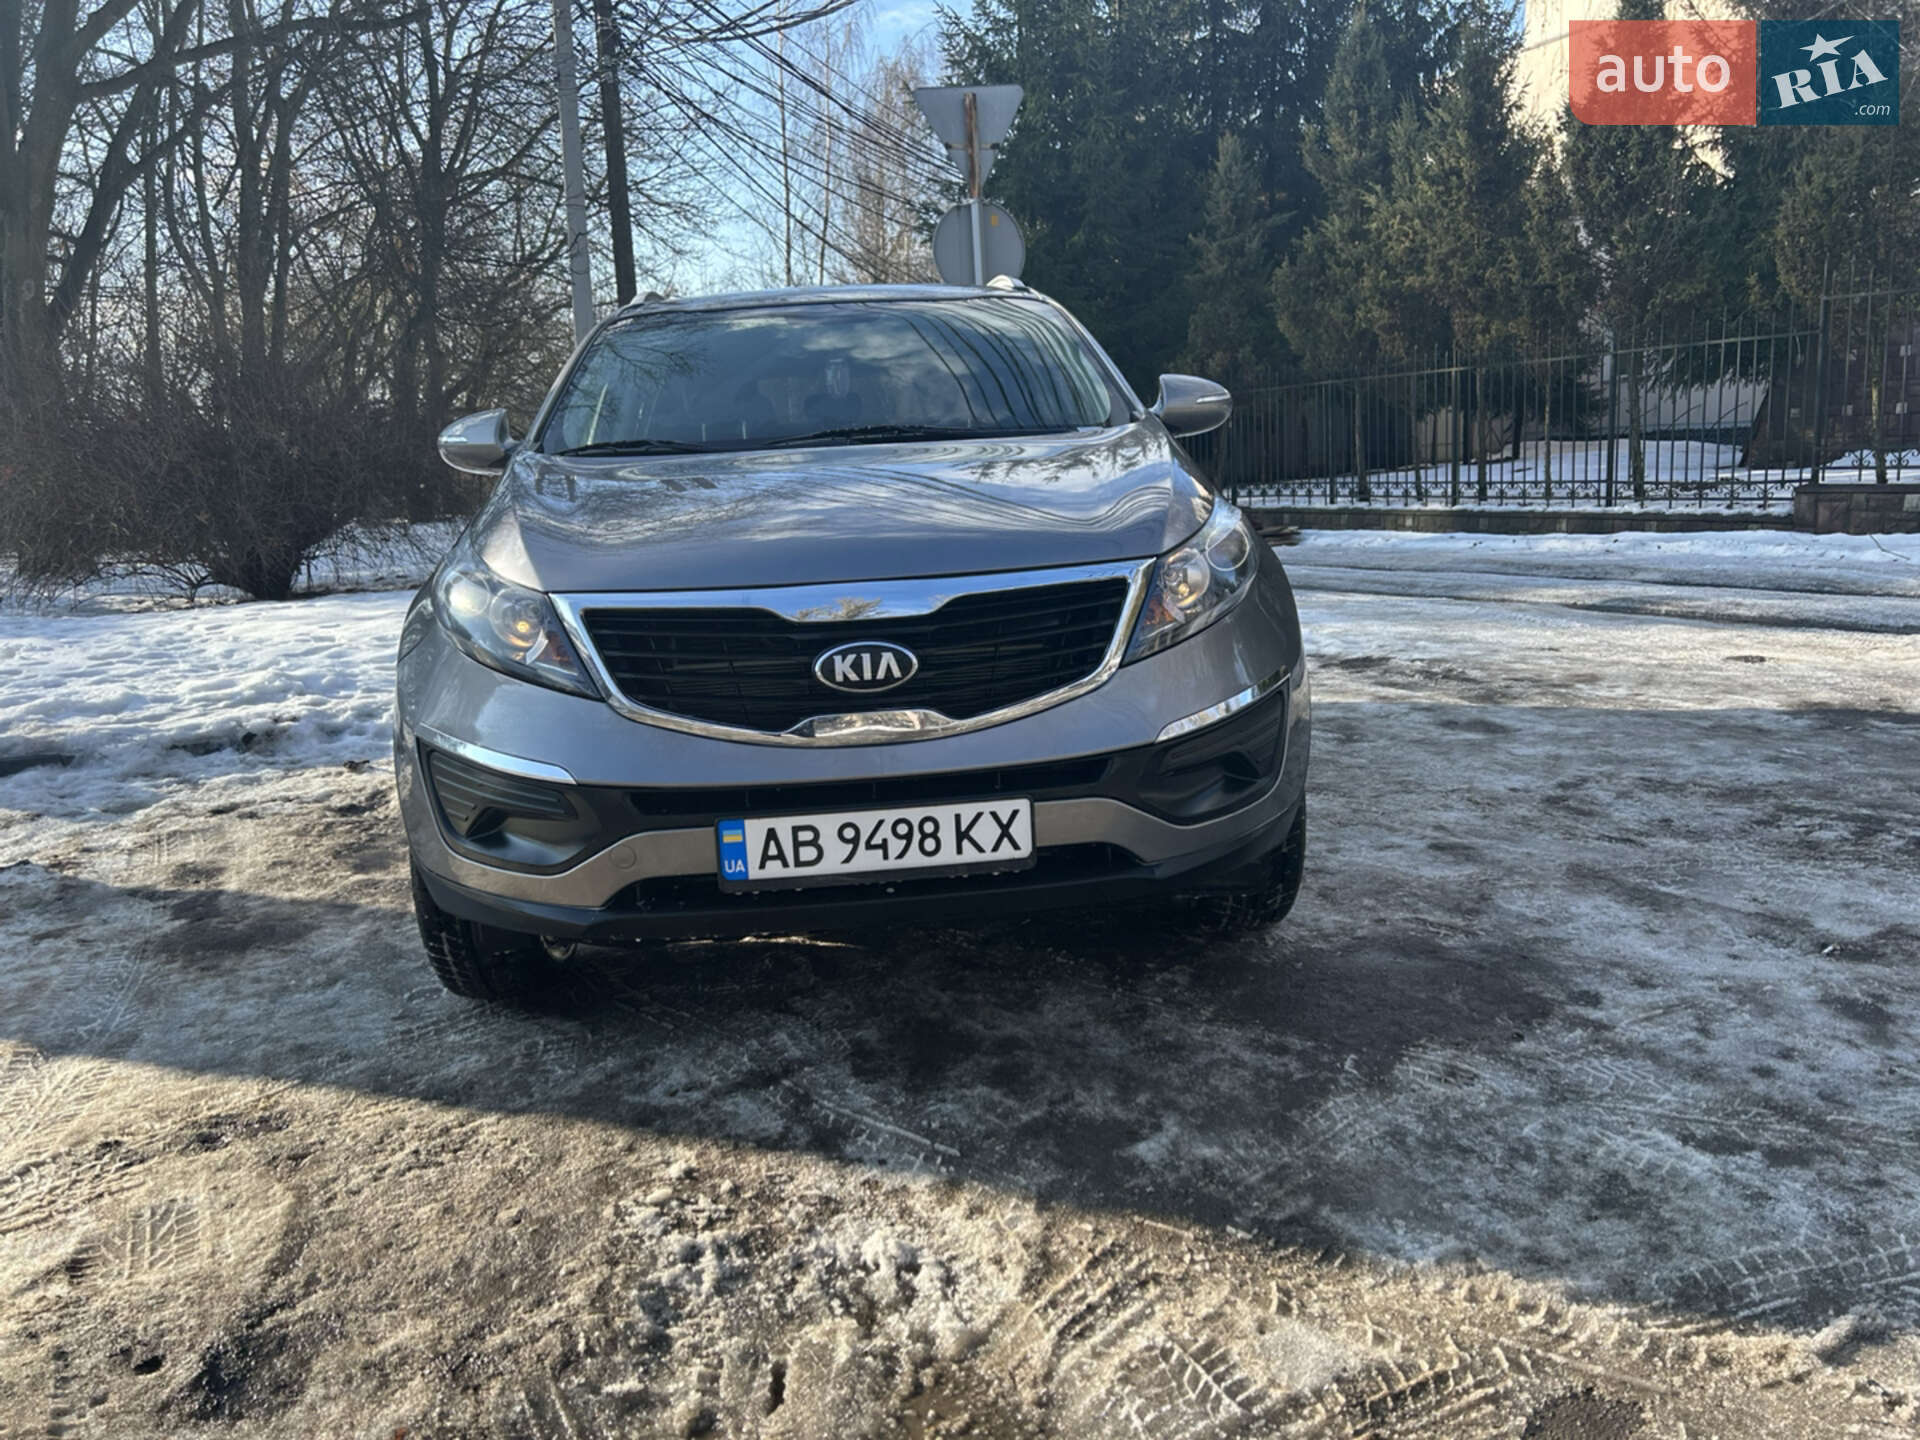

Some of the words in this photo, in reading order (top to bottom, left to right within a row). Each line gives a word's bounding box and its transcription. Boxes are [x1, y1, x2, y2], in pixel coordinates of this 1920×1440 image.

[832, 651, 902, 682] KIA
[758, 824, 824, 870] AB
[837, 815, 942, 864] 9498
[953, 809, 1022, 855] KX
[724, 858, 746, 873] UA
